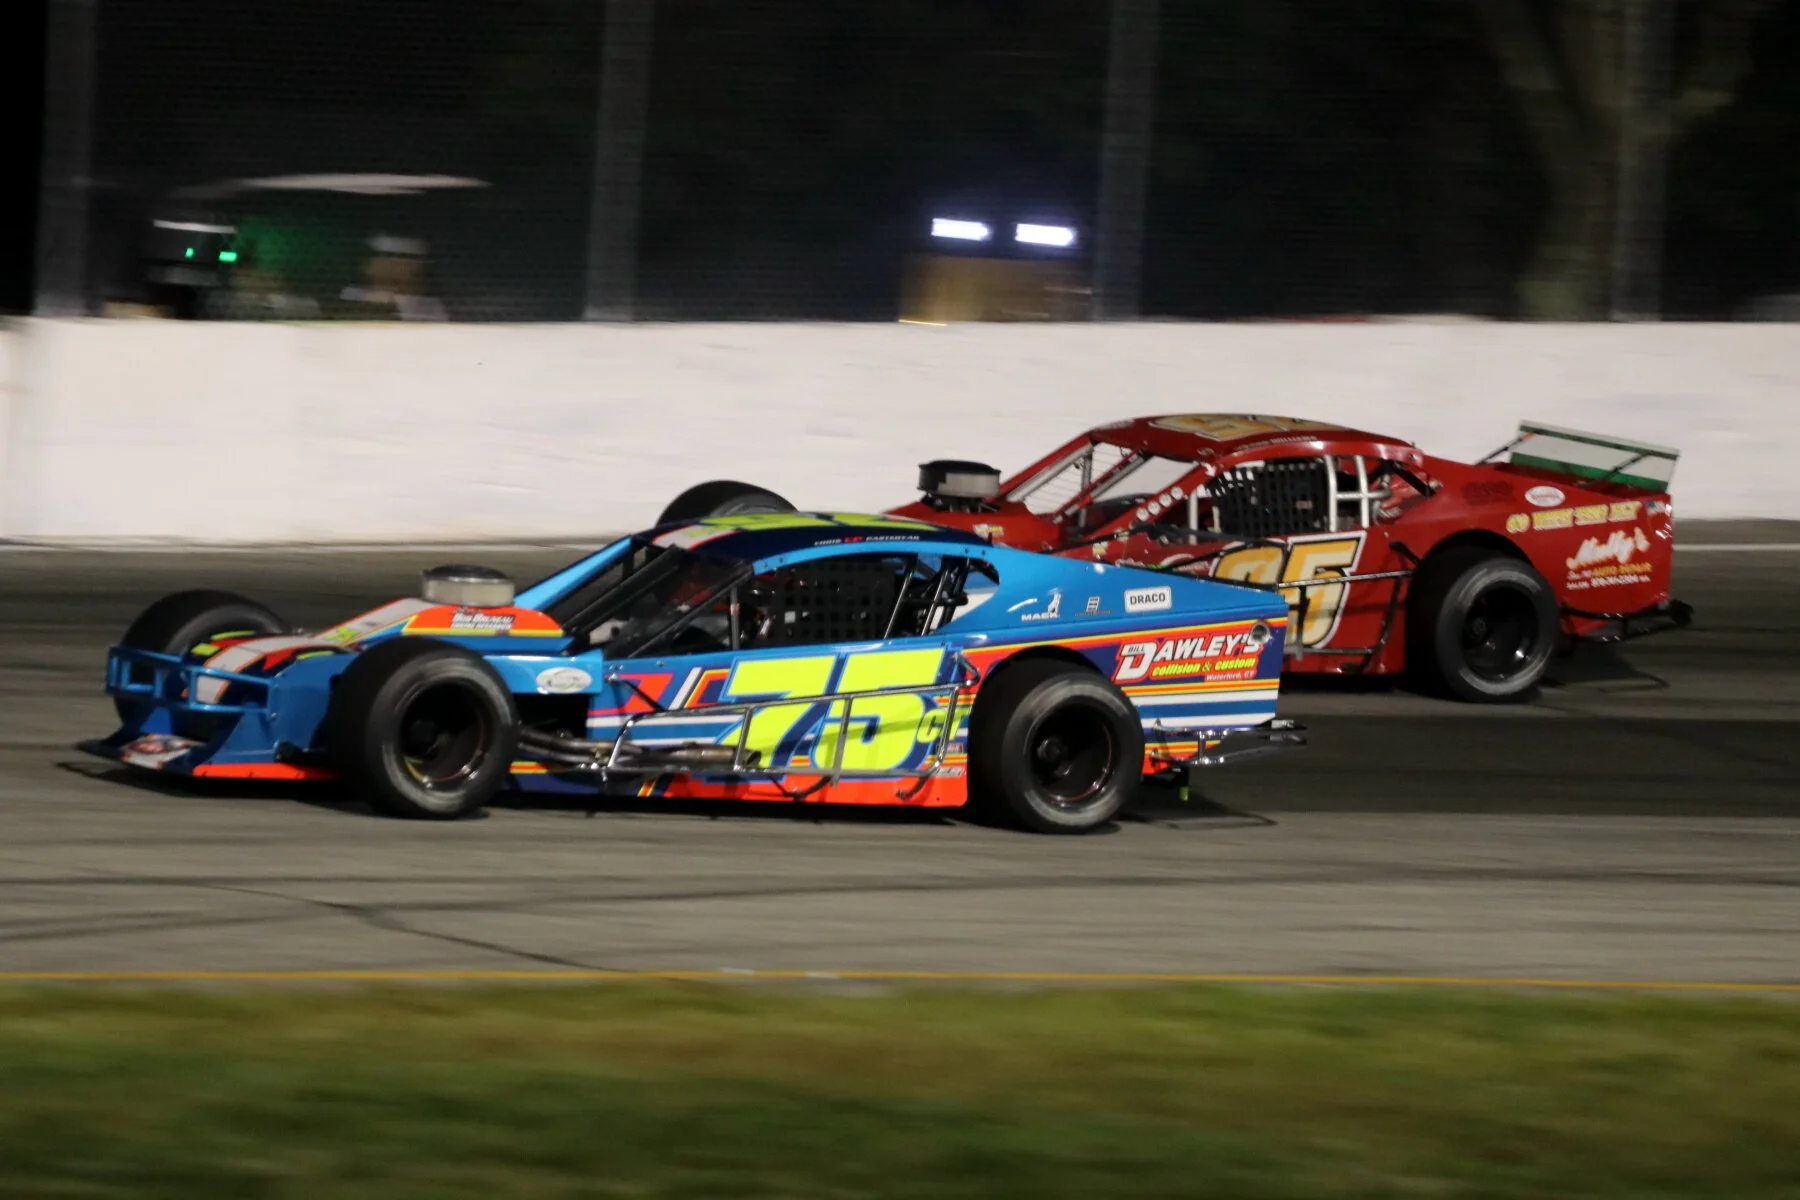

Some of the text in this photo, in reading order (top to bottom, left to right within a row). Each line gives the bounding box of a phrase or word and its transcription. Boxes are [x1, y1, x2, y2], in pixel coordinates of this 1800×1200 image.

[1129, 592, 1167, 606] DRACO
[1152, 656, 1257, 677] collision & custom
[715, 648, 946, 771] 75
